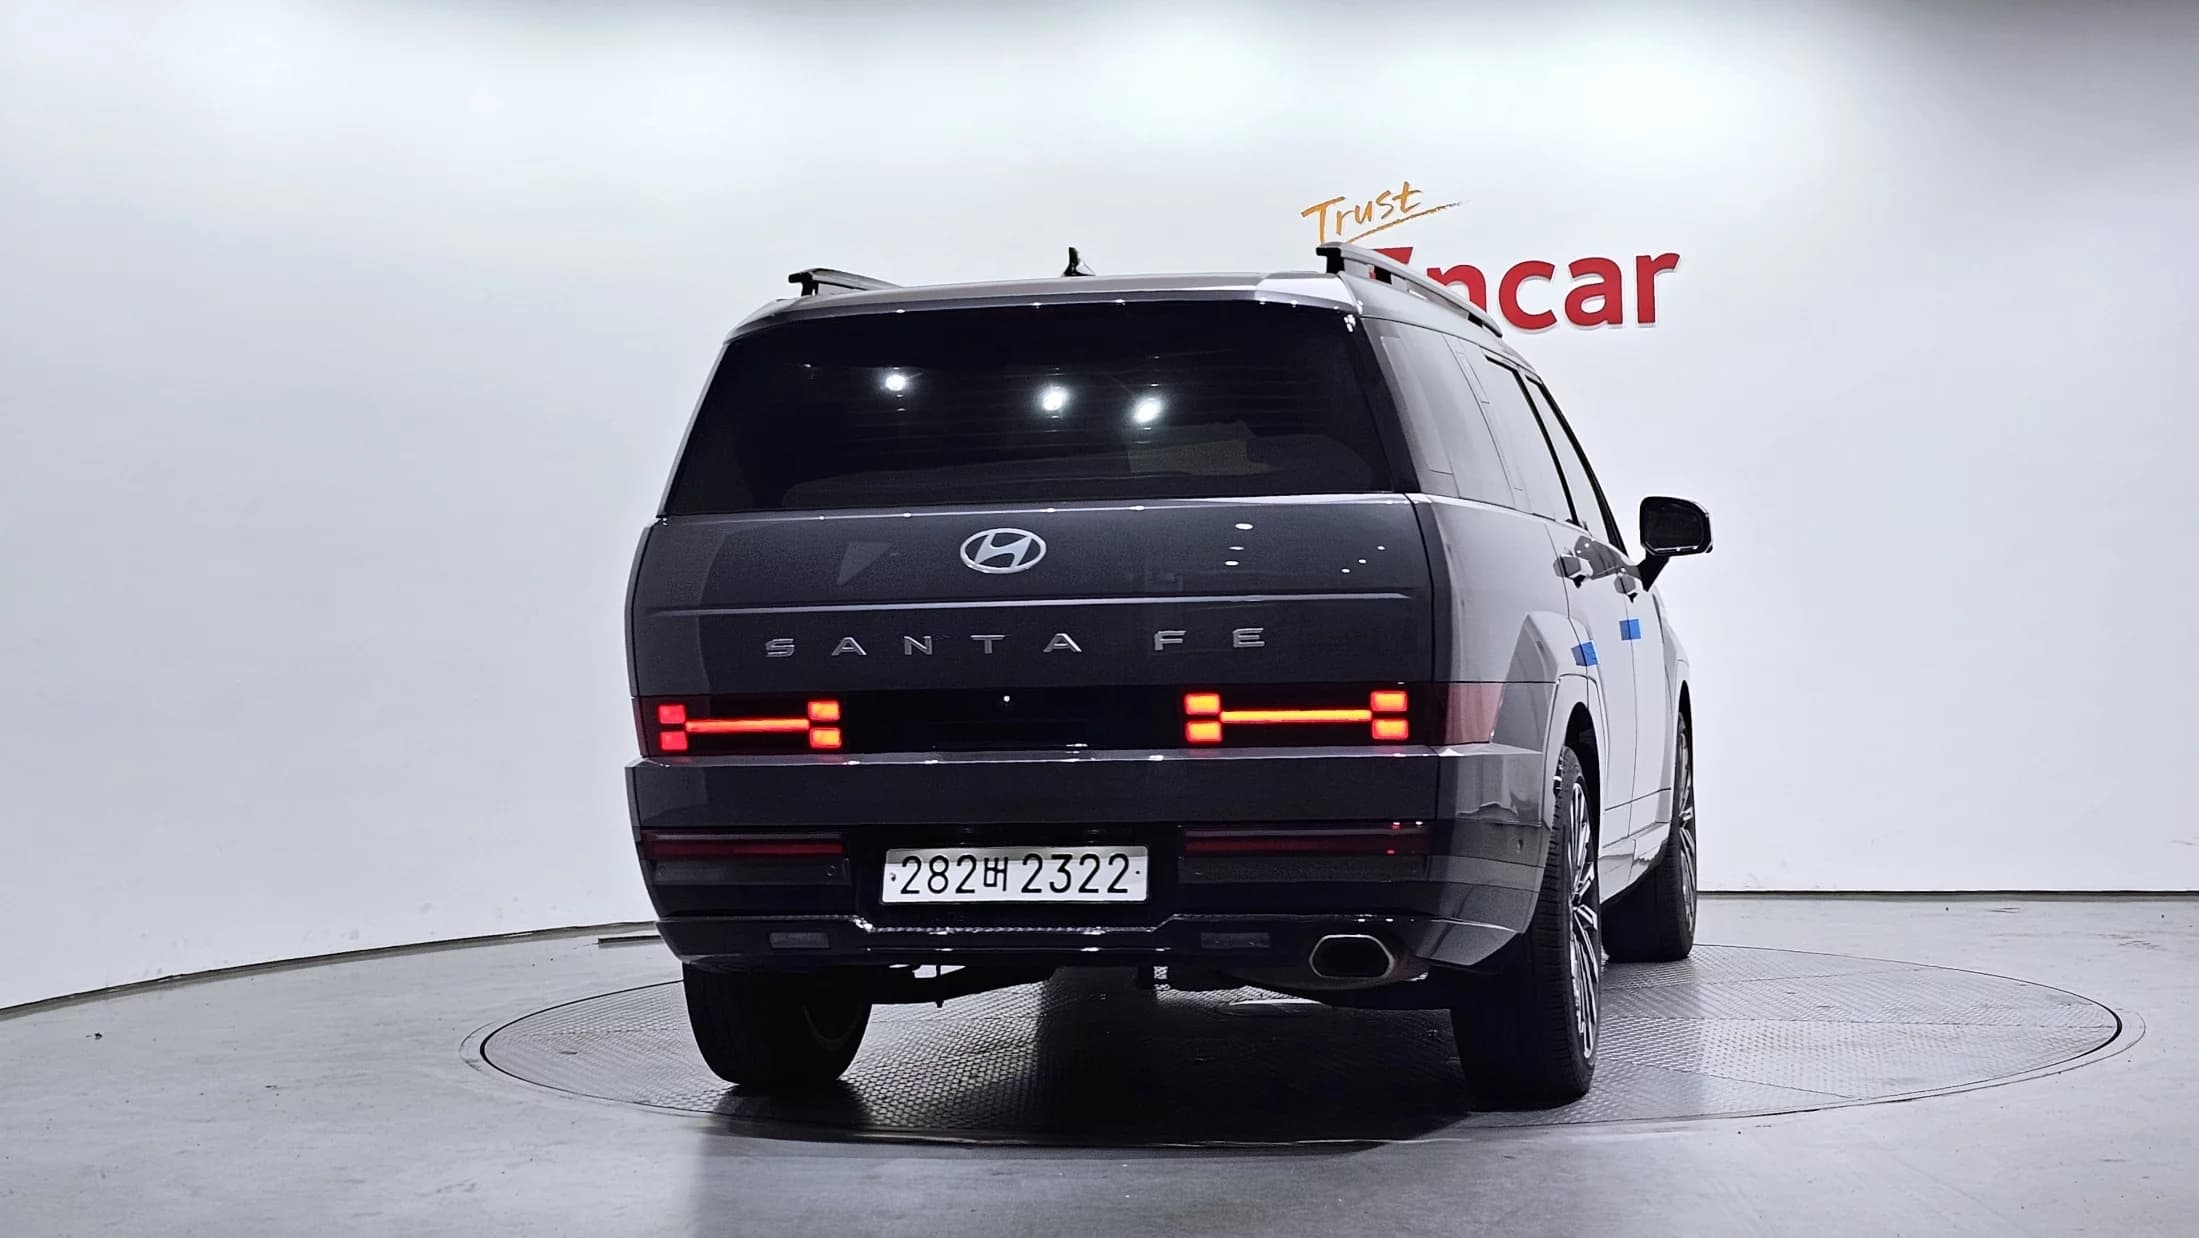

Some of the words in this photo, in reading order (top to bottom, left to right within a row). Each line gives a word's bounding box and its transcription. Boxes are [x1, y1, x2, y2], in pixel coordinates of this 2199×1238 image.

[1301, 181, 1422, 245] Trust
[1368, 246, 1681, 330] ncar
[765, 632, 1083, 657] SANTA
[1153, 627, 1265, 651] FE
[1021, 853, 1130, 893] 2322
